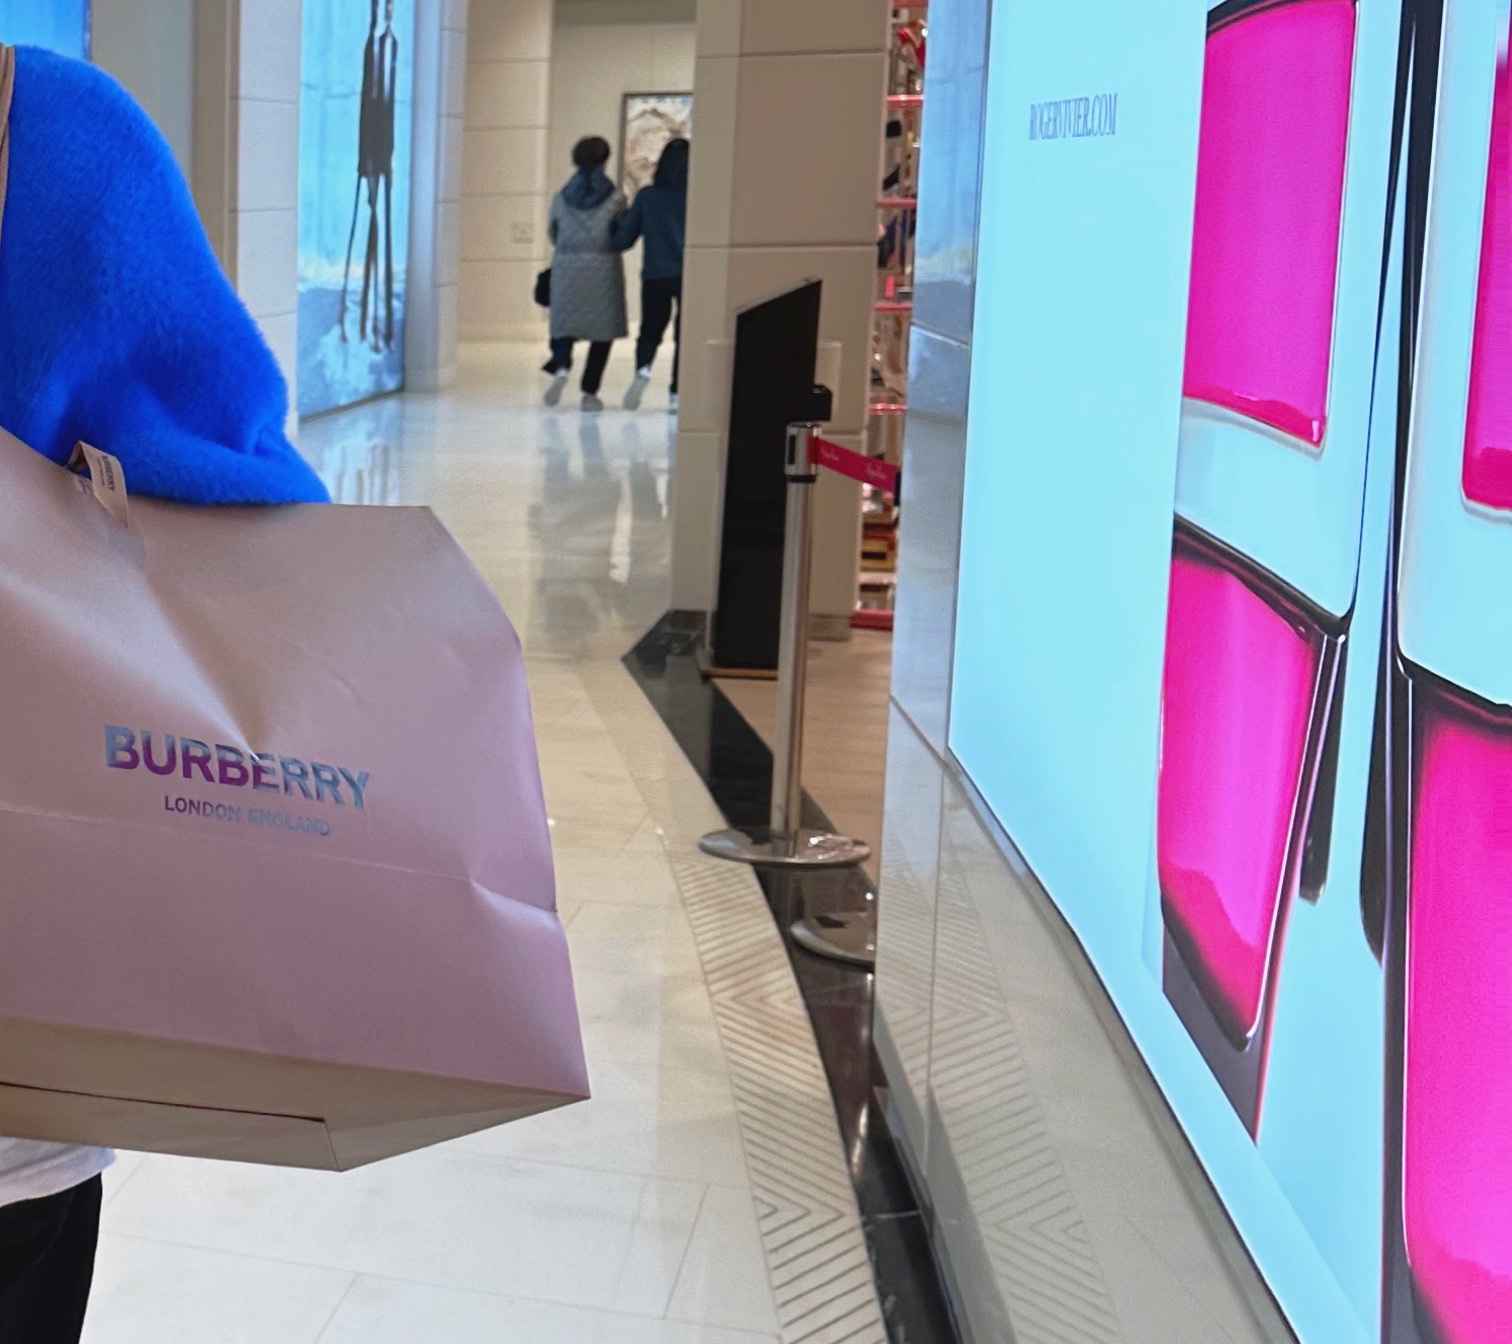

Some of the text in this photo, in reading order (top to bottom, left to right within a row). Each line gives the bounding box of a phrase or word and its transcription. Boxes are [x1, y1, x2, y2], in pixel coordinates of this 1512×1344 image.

[103, 723, 370, 810] BURBERRY
[164, 794, 330, 836] LONDON ENGLAND
